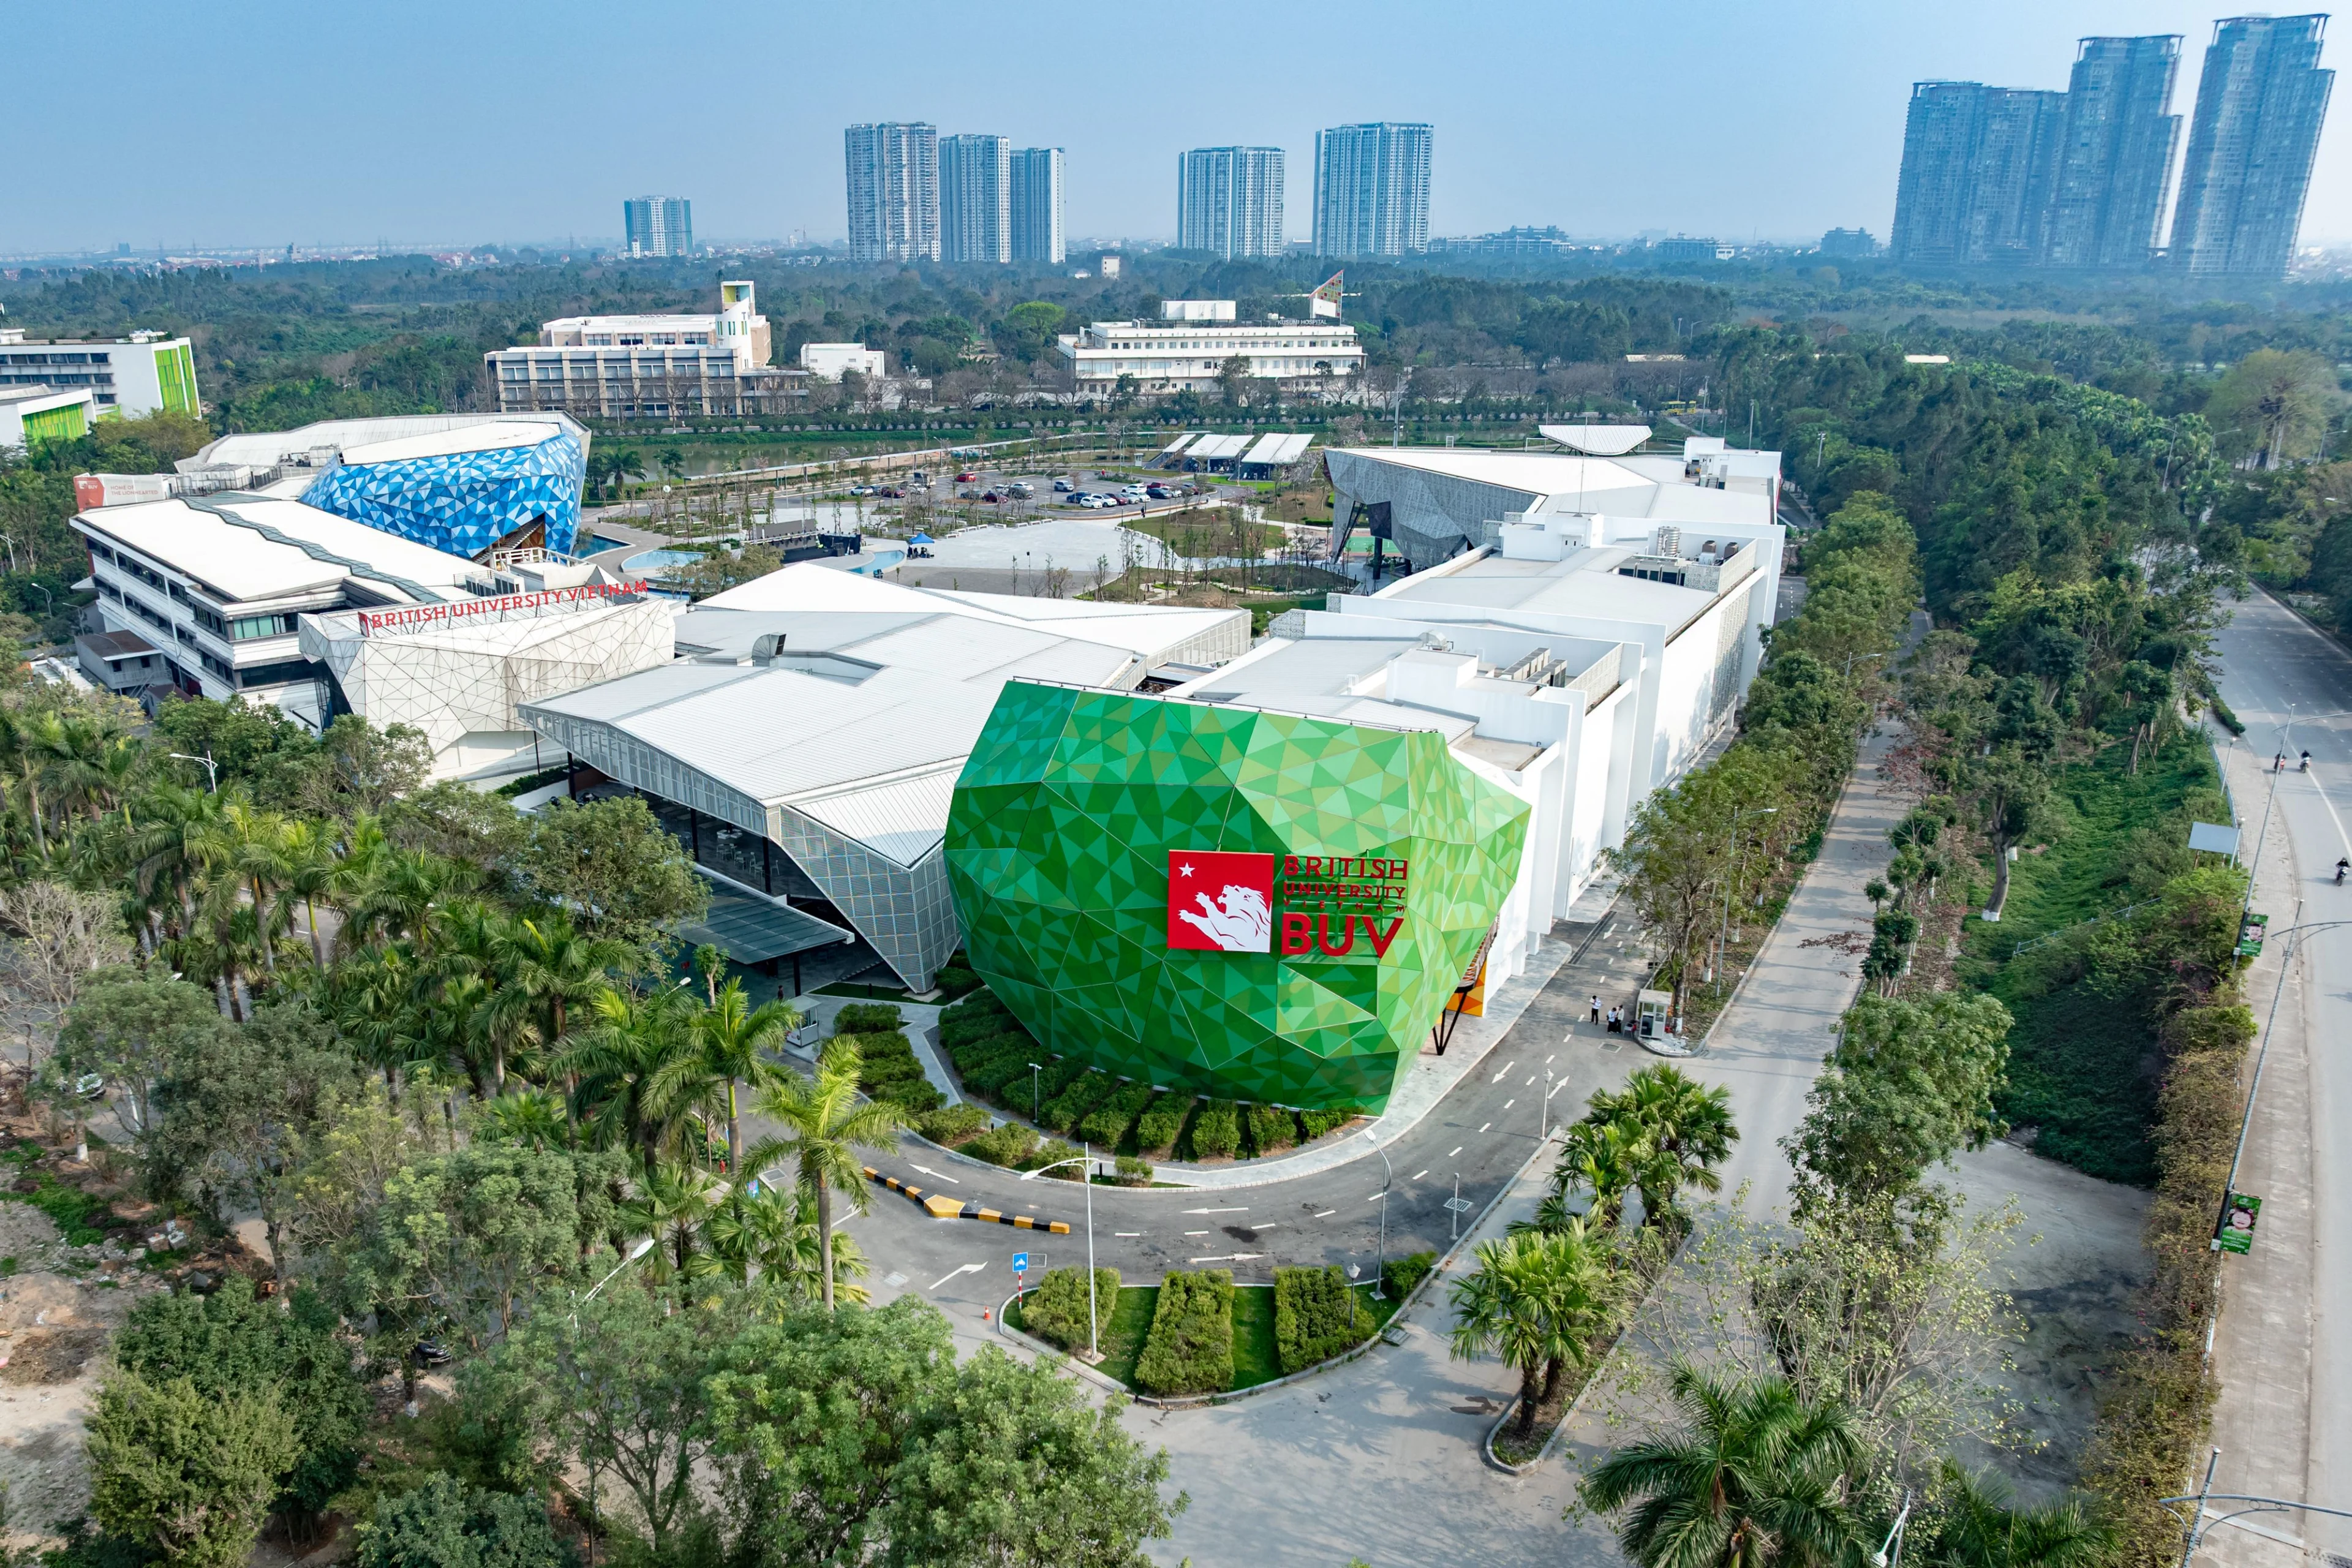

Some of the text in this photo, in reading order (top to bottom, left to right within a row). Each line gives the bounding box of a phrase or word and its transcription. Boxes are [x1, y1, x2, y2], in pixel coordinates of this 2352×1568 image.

[371, 579, 649, 628] BRITISH UNIVERSITY VIETNAM
[1284, 854, 1408, 880] BRITISH
[1283, 881, 1406, 900] UNIVERSITY
[1284, 899, 1406, 913] VIETNAM
[1281, 912, 1404, 959] BUV
